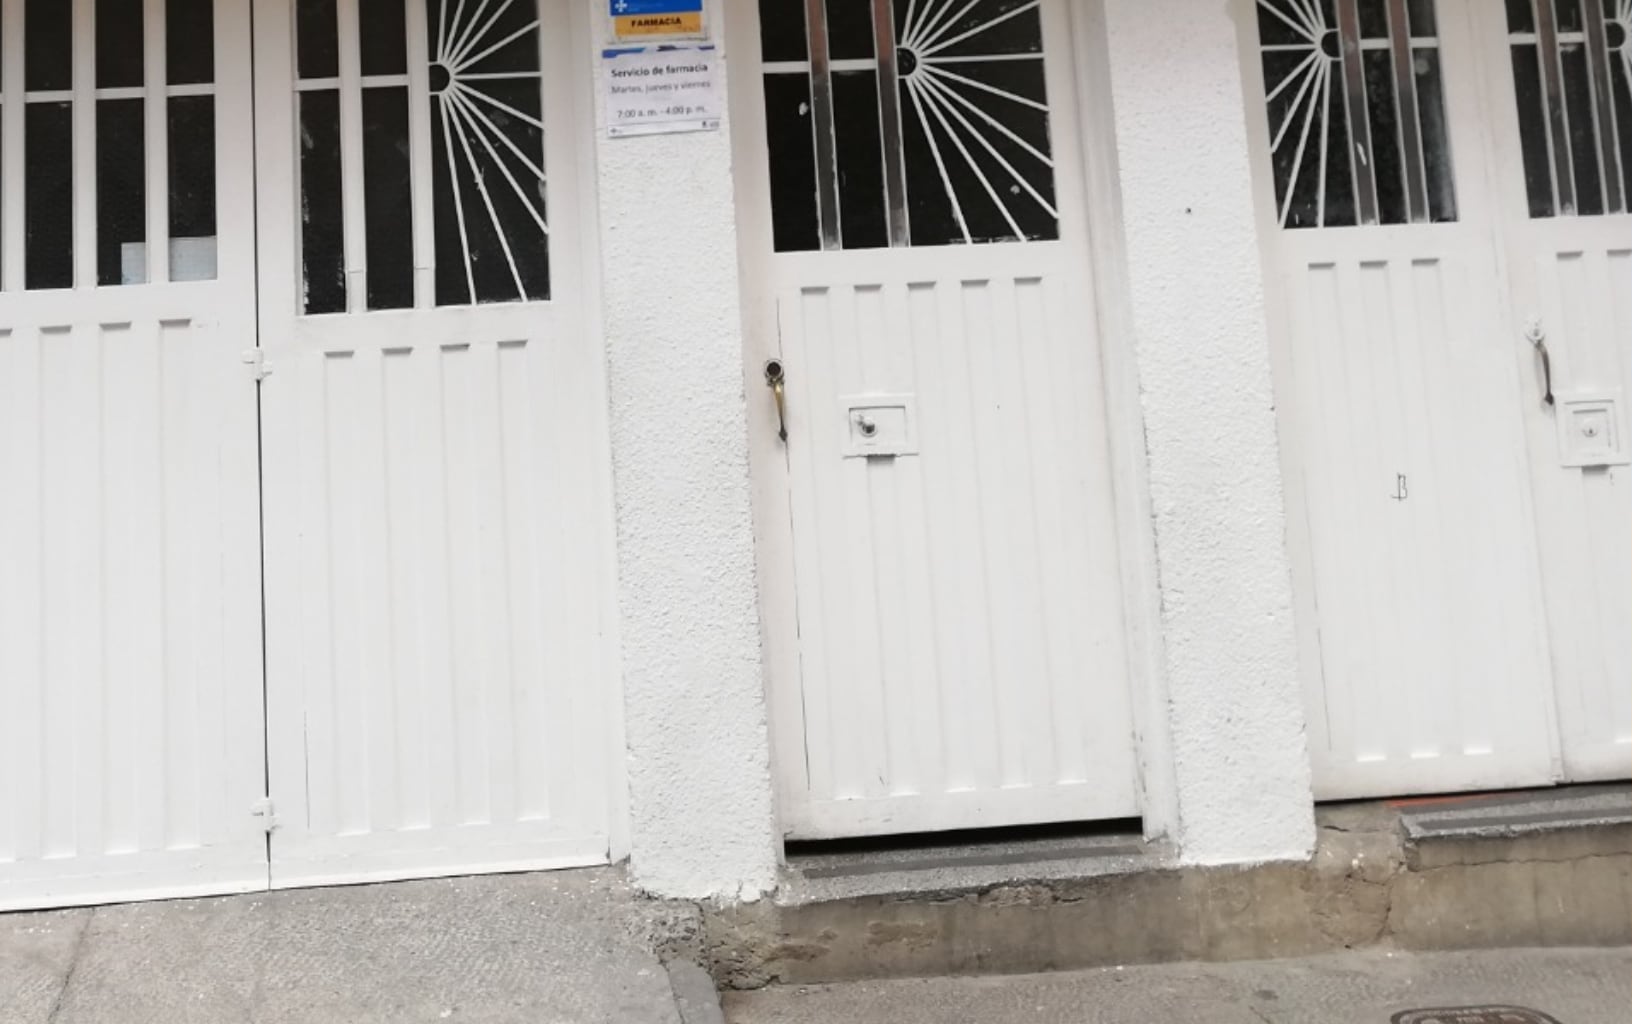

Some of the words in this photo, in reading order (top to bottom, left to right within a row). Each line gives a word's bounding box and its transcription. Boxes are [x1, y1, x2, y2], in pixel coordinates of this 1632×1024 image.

[611, 67, 650, 77] Servicio
[652, 66, 663, 75] de
[666, 64, 708, 74] farmacia
